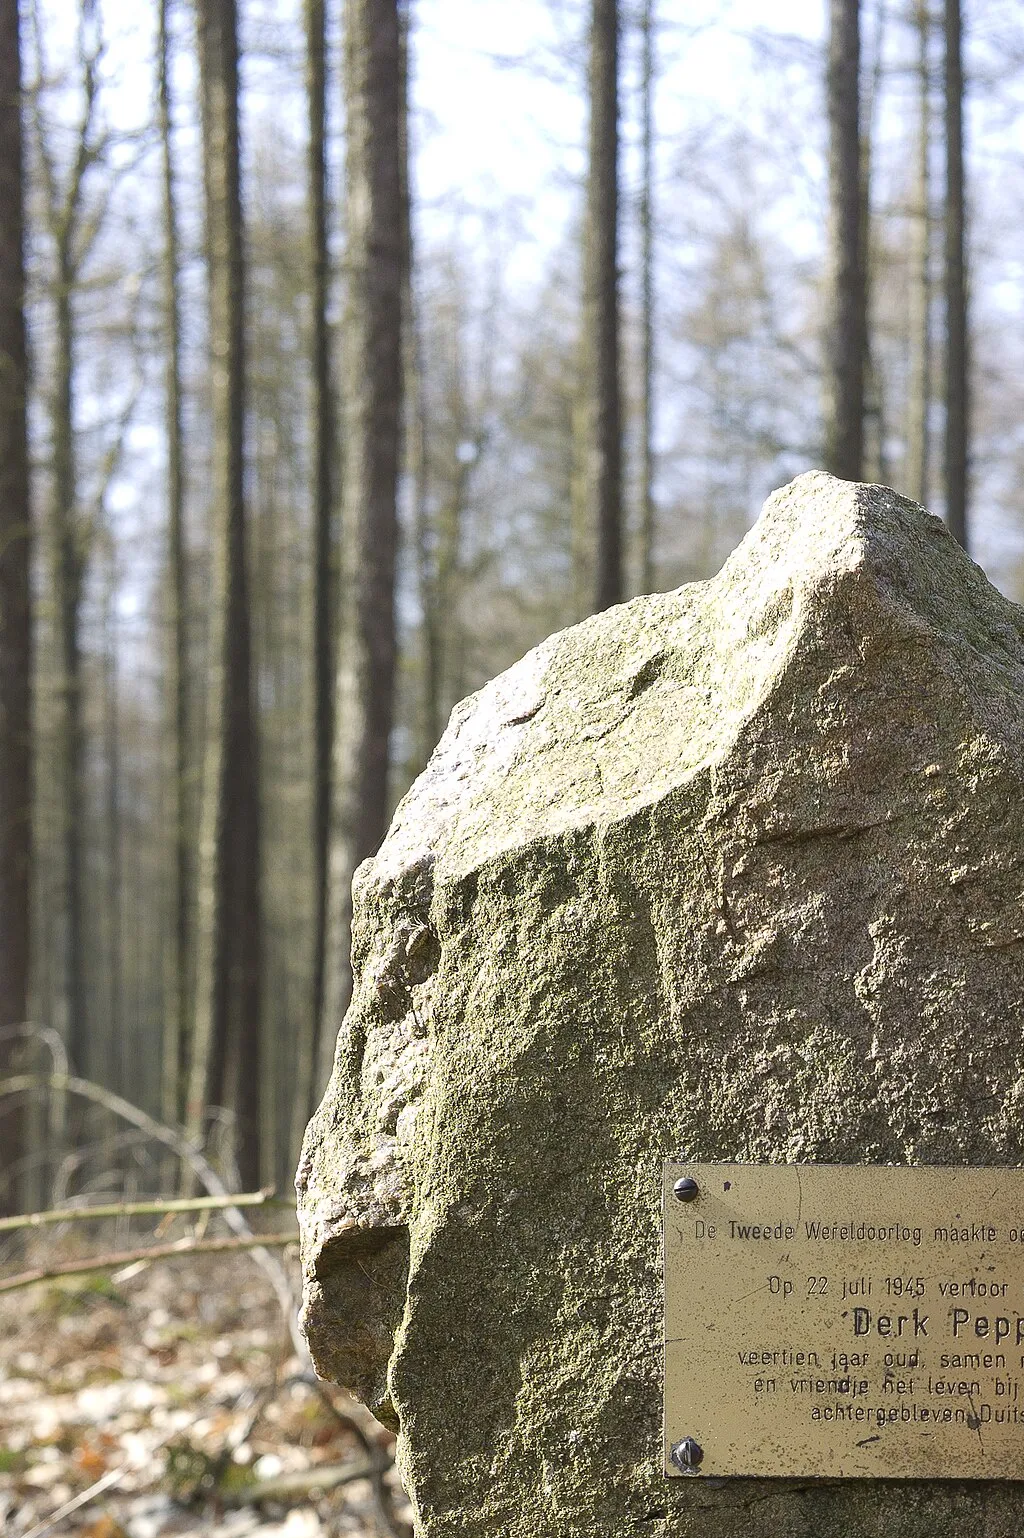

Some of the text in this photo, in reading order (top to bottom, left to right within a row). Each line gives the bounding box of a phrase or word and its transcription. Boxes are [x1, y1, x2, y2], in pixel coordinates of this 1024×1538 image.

[695, 1220, 717, 1240] De
[728, 1220, 794, 1241] Tweede
[805, 1222, 922, 1246] Wereldoorlog
[934, 1224, 997, 1242] maakte
[769, 1276, 793, 1299] Op
[807, 1277, 828, 1295] 22
[841, 1277, 873, 1300] juli
[884, 1277, 926, 1297] 1945
[938, 1278, 1008, 1298] verloor
[854, 1307, 930, 1336] Derk
[738, 1351, 819, 1366] veertien
[832, 1351, 870, 1371] jaar
[940, 1353, 1006, 1369] samen
[754, 1379, 775, 1393] en
[790, 1377, 869, 1398] vriendje
[884, 1376, 914, 1395] het
[927, 1376, 981, 1396] leven
[995, 1378, 1018, 1401] bij
[811, 1403, 966, 1427] achtergebleven
